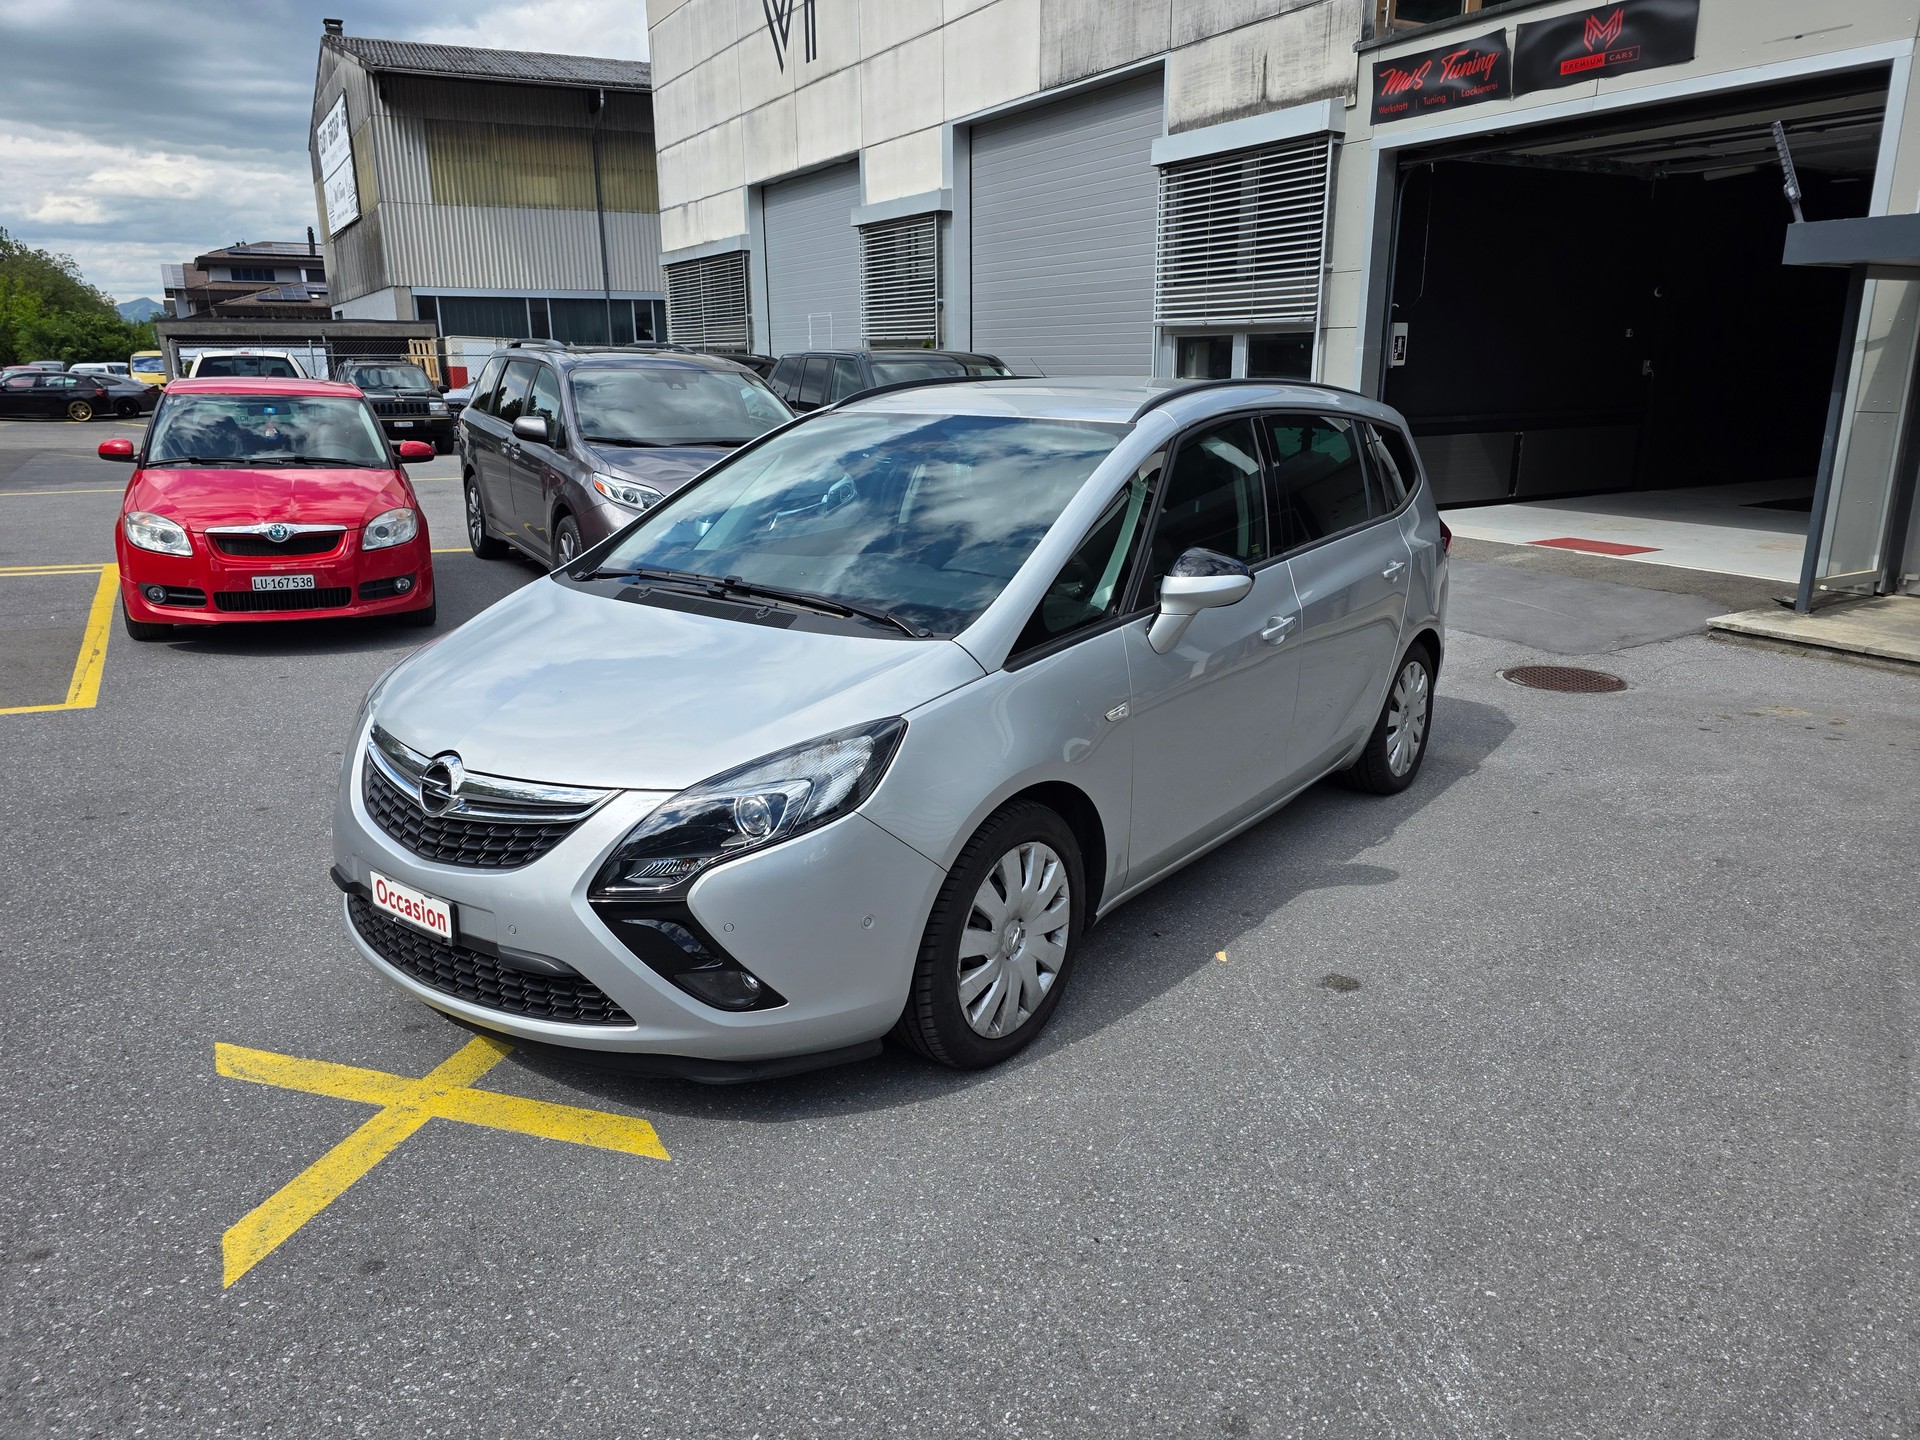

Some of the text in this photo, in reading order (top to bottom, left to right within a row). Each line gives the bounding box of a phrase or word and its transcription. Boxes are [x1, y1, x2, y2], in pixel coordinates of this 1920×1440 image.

[1440, 48, 1500, 83] Tuning
[1563, 50, 1633, 71] PREMIUM CARS
[1378, 81, 1499, 114] Werkstatt Tuning Lackiererei
[376, 879, 447, 932] Occasion
